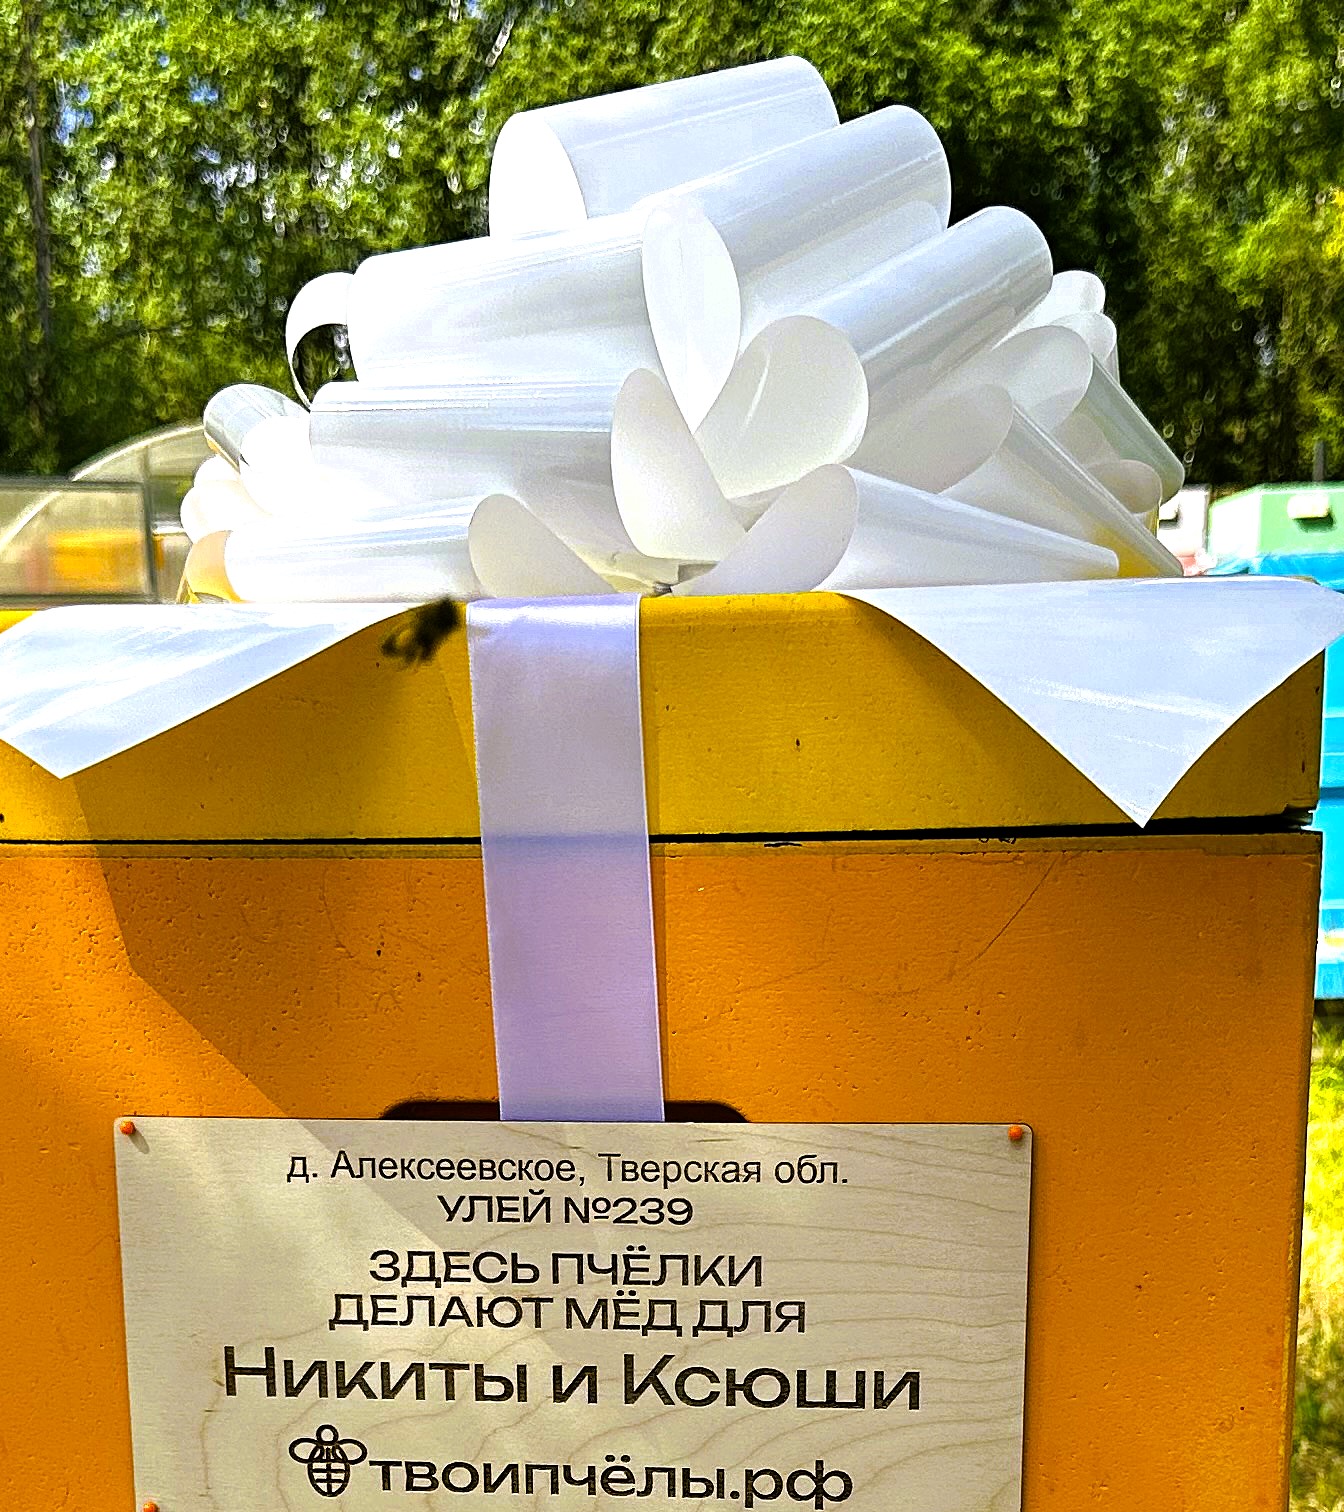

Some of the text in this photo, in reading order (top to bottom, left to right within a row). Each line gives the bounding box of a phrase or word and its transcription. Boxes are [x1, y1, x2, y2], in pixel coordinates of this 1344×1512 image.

[285, 1150, 850, 1191] д. Алексеевское, Тверская обл.
[436, 1188, 695, 1227] УЛЕЙ №239
[368, 1244, 763, 1289] ЗДЕСЬ ПЧЁЛКИ
[327, 1289, 807, 1338] ДЕЛАЮТ МЁД ДЛЯ
[222, 1345, 922, 1412] Никиты и Ксюши
[367, 1453, 854, 1512] твоипчёлы.рф
